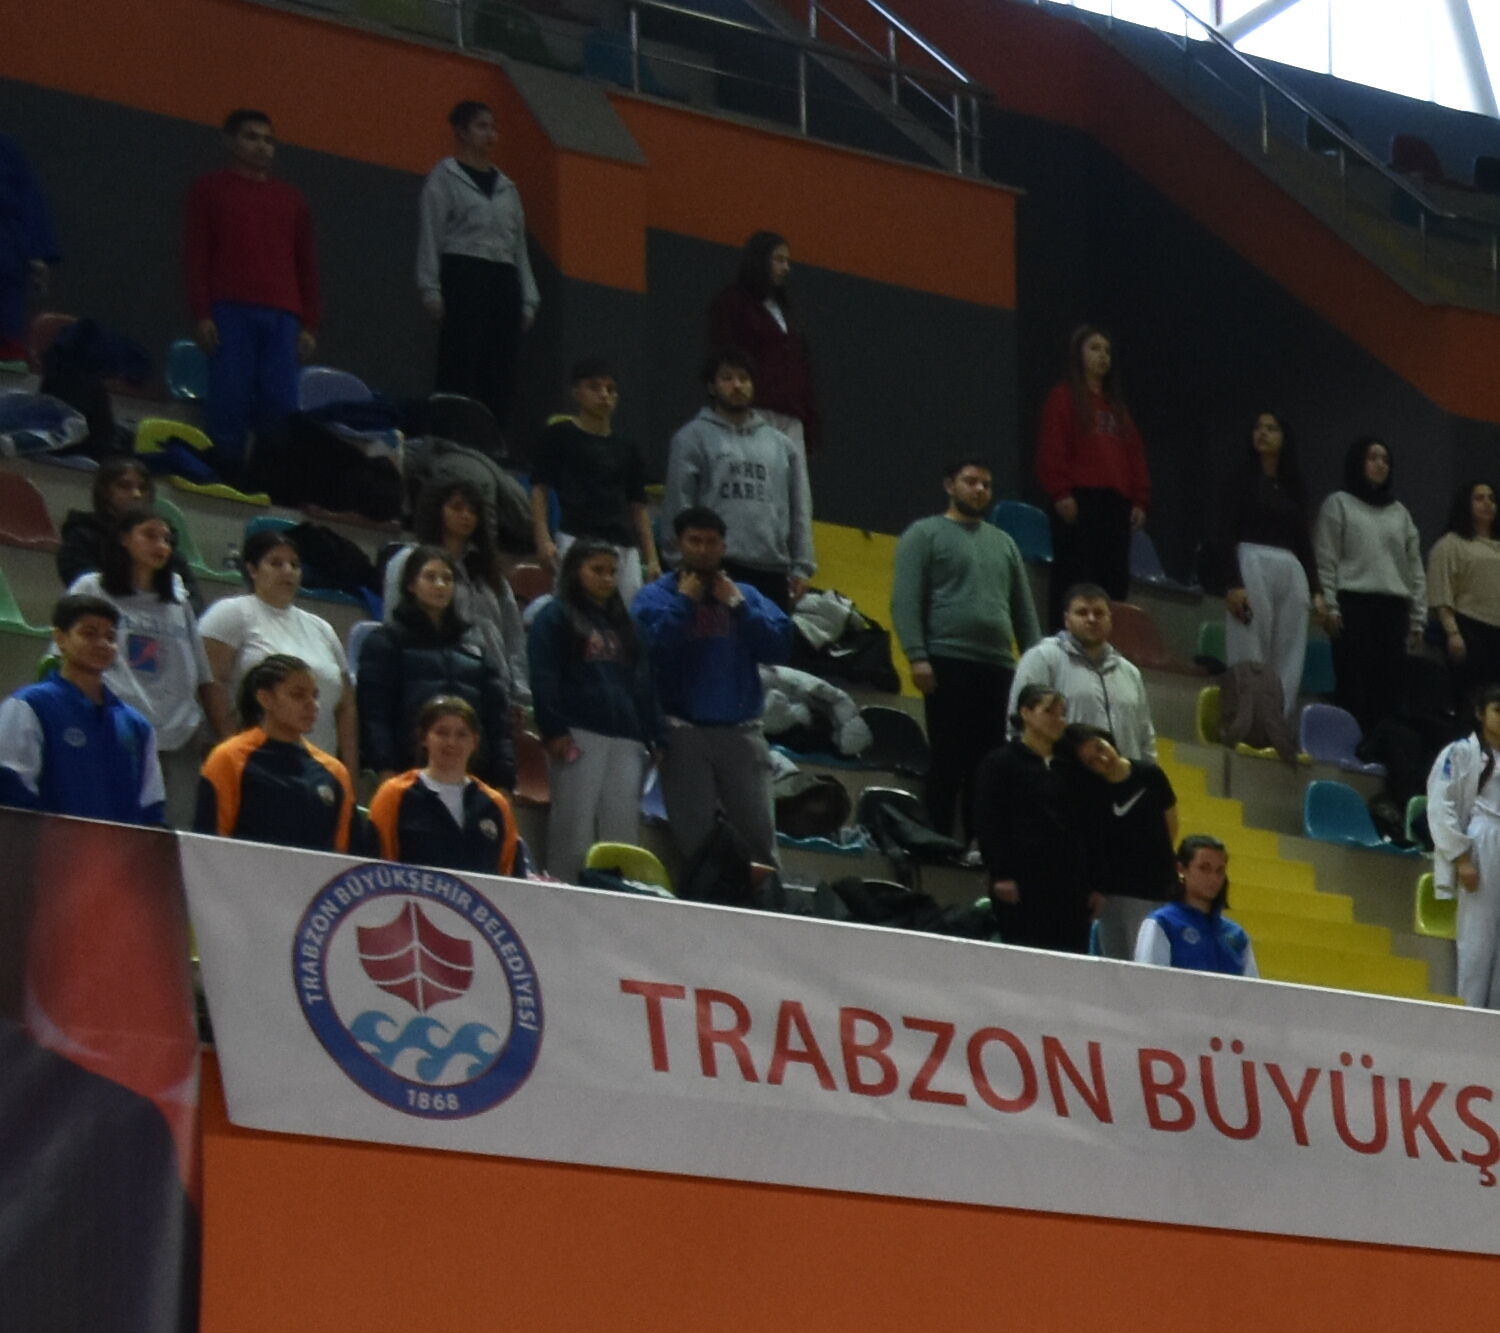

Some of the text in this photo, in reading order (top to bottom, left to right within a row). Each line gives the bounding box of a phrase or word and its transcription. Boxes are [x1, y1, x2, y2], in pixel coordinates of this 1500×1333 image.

[301, 903, 341, 1005] TRABZON
[333, 866, 474, 912] BÜYÜKŞEHİR
[407, 1089, 461, 1111] 1868
[620, 979, 1113, 1124] TRABZON
